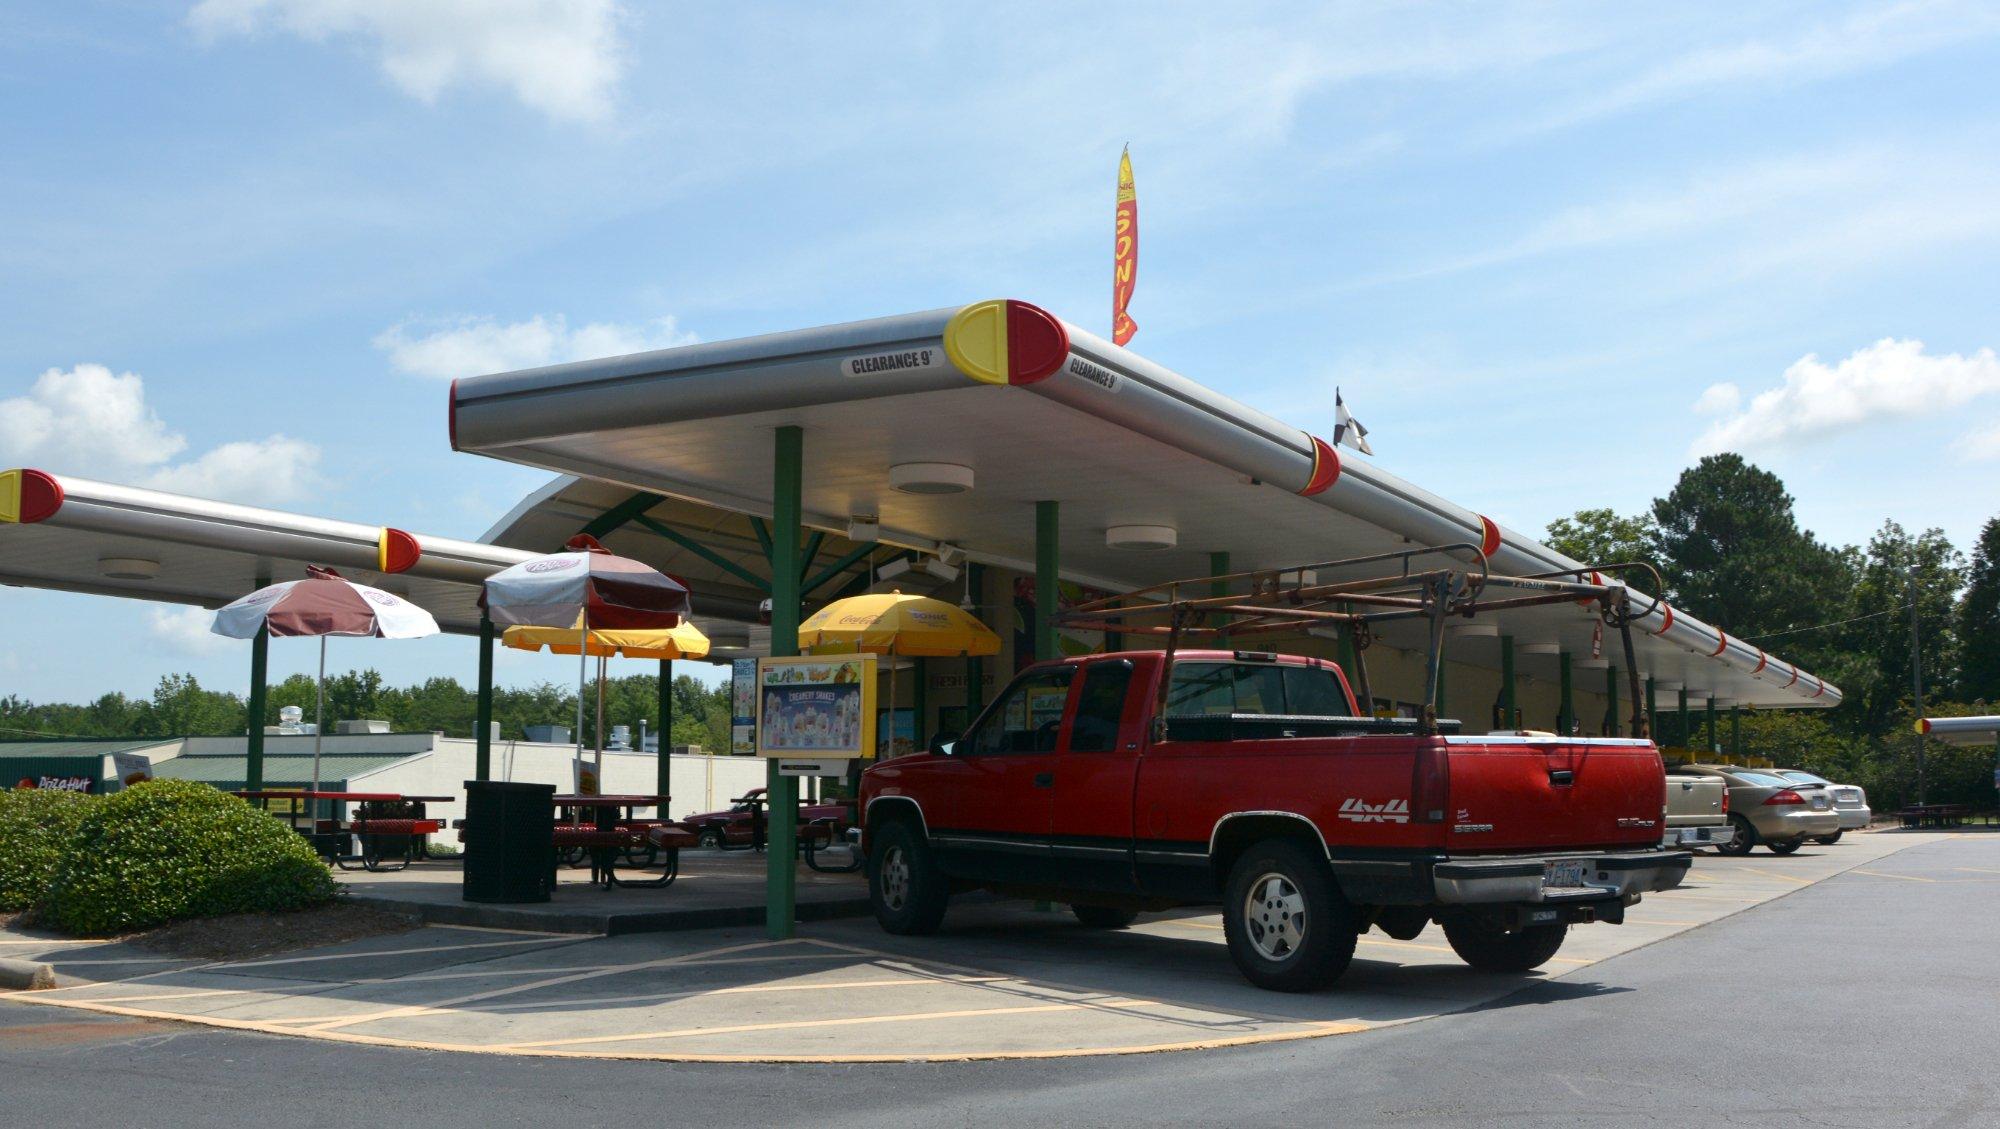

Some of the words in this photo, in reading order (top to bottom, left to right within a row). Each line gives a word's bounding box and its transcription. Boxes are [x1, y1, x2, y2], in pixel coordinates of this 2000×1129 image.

[851, 351, 920, 374] CLEARANCE
[920, 349, 933, 366] 9'
[1070, 358, 1110, 387] CLEARANCE
[1107, 374, 1118, 389] 9'
[788, 691, 815, 701] CREAMERY
[815, 690, 835, 701] SHAKES
[39, 776, 67, 790] Pizza
[66, 776, 91, 793] Hut
[1338, 798, 1410, 824] 4x4
[1454, 824, 1493, 833] SIERRA
